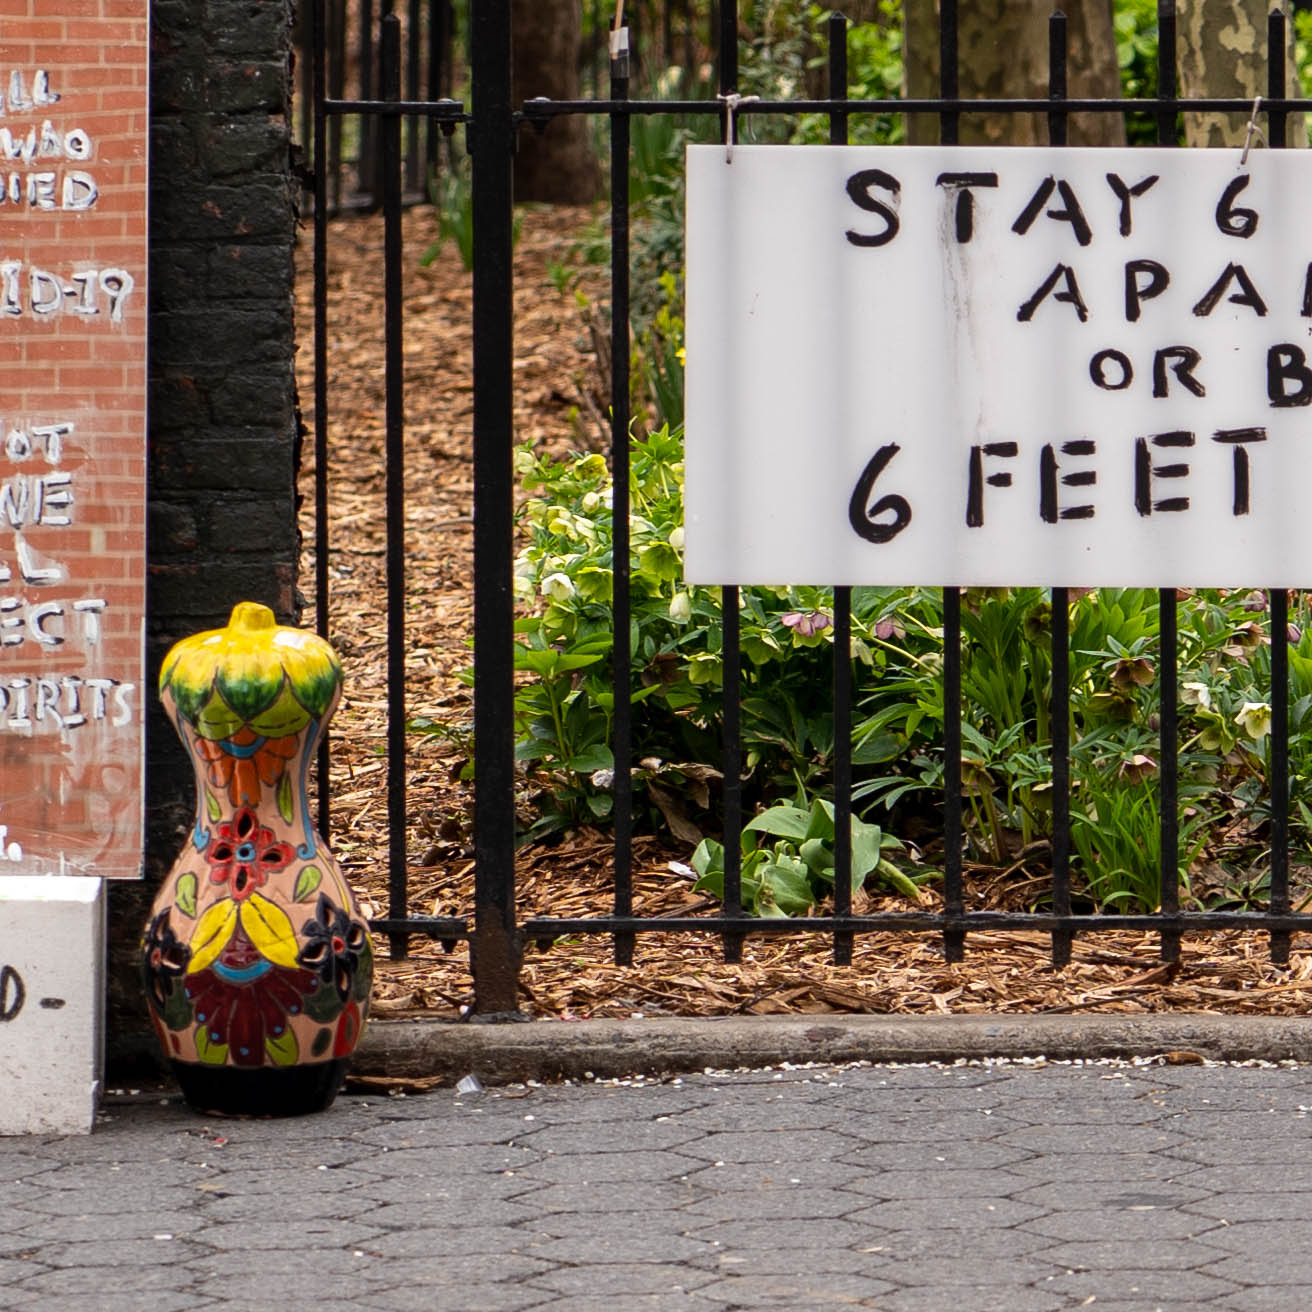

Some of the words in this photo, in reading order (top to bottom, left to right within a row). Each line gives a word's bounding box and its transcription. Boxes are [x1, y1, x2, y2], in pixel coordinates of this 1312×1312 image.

[844, 168, 1160, 249] STAY
[1214, 172, 1260, 241] 6
[1089, 344, 1206, 400] OR
[848, 441, 913, 545] 6
[964, 426, 1269, 528] FEET
